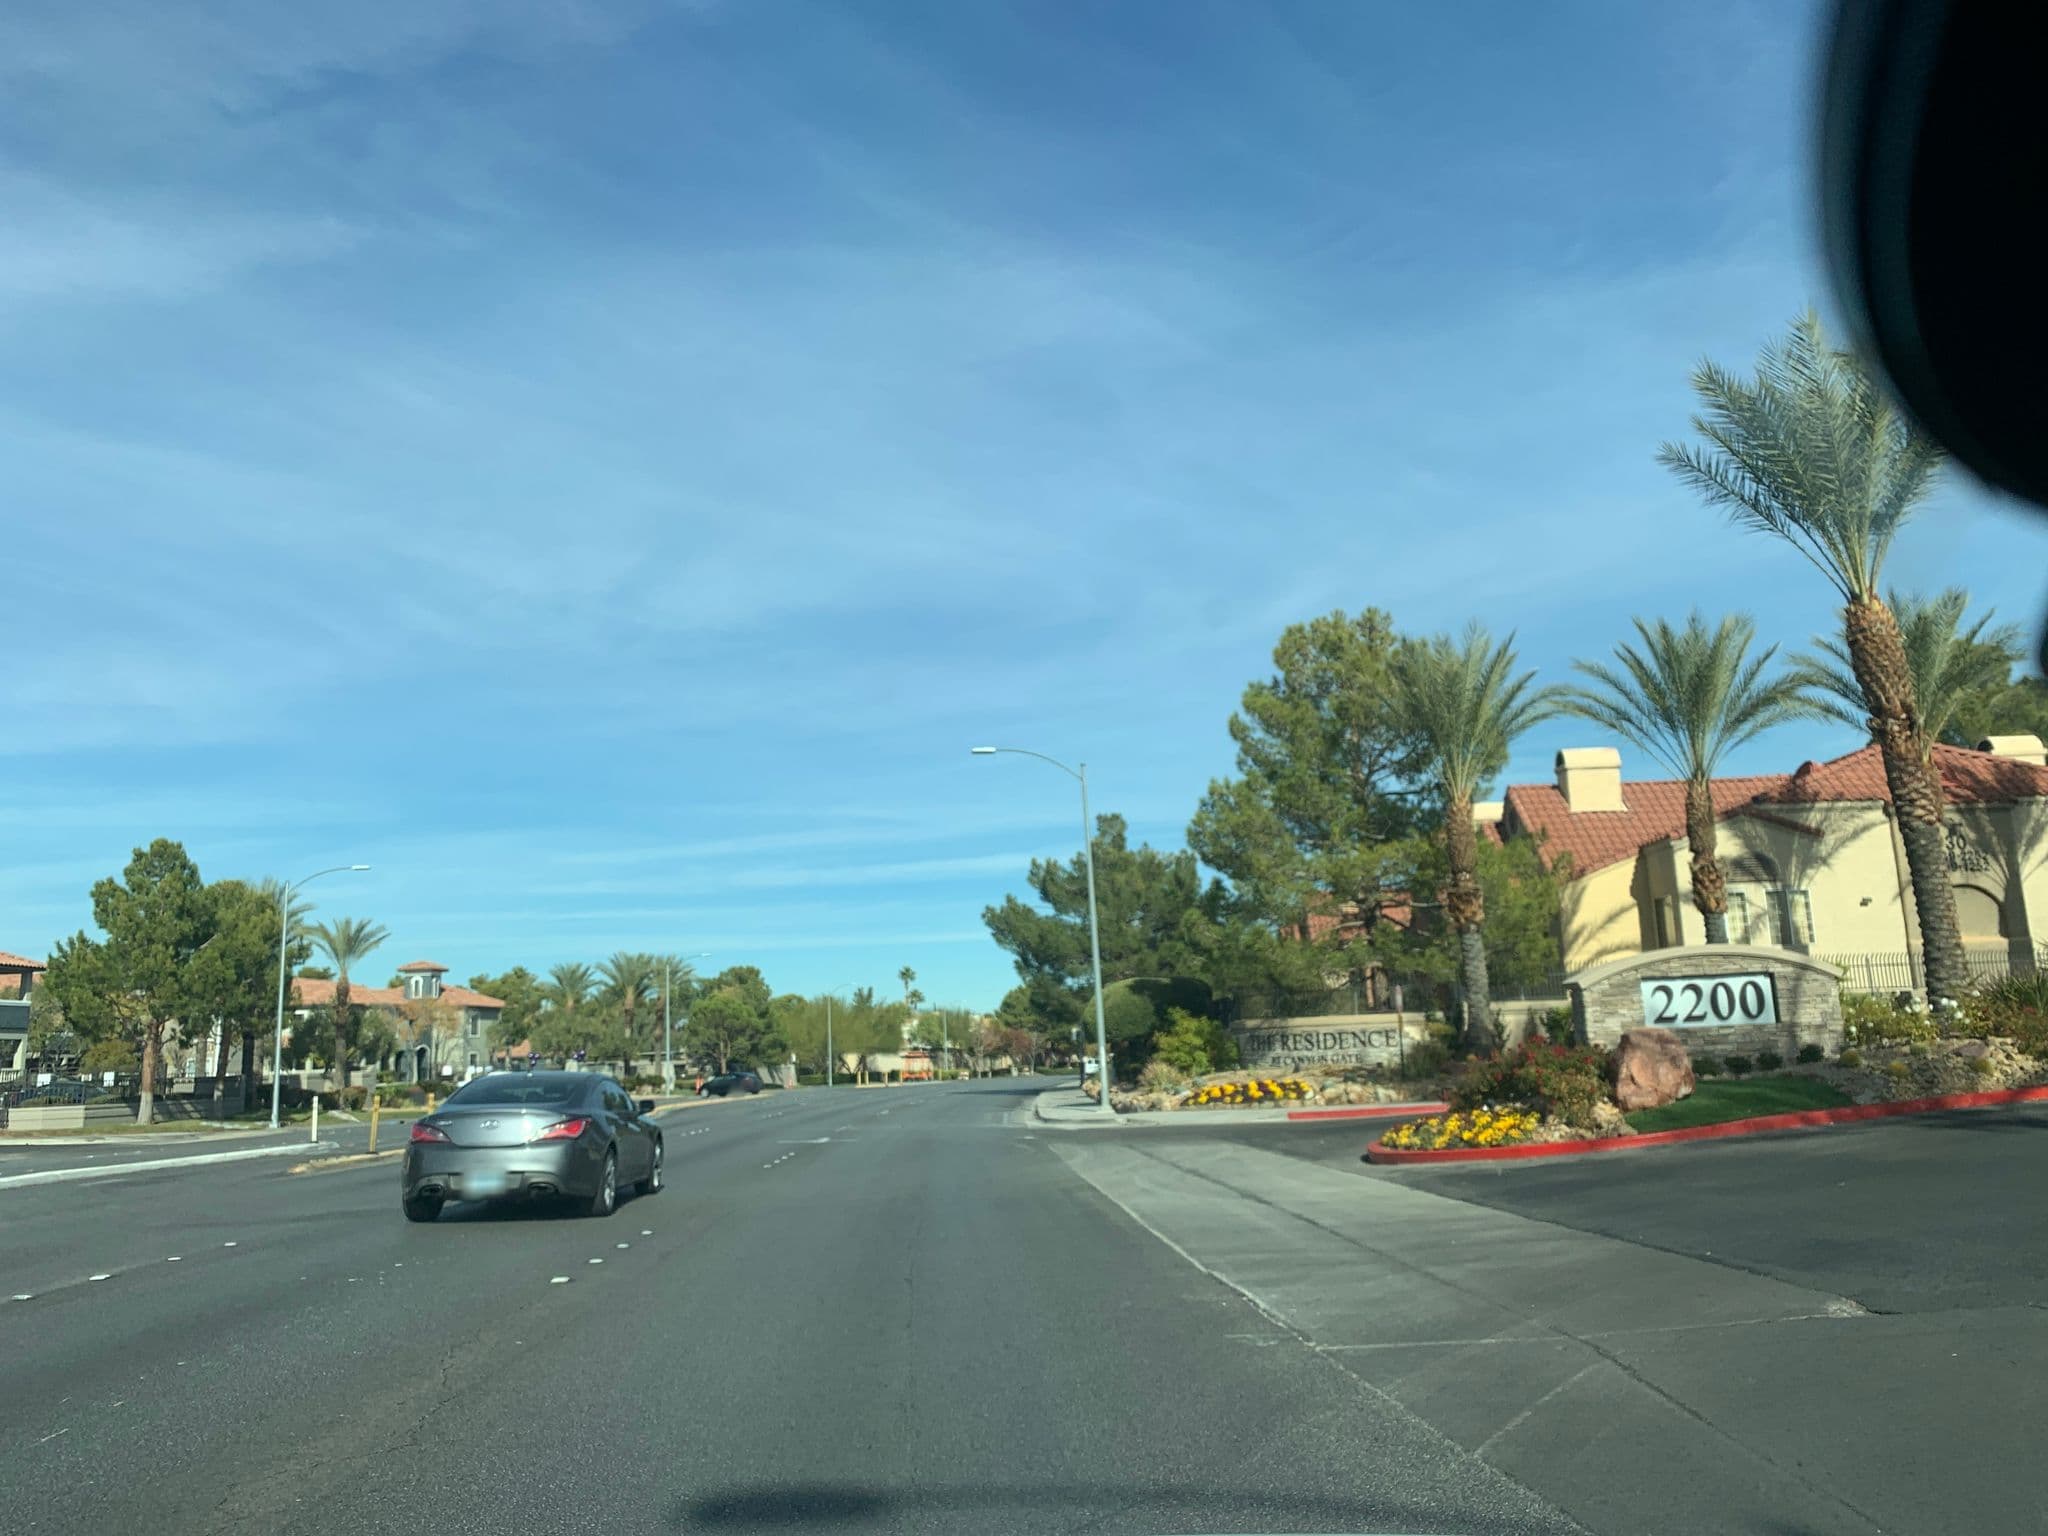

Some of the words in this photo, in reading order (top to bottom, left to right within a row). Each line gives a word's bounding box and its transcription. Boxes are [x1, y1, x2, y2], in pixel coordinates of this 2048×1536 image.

[1650, 980, 1766, 1024] 2200
[1248, 1033, 1277, 1051] THE
[1280, 1028, 1398, 1051] RESIDENCE
[1331, 1053, 1363, 1065] GATE
